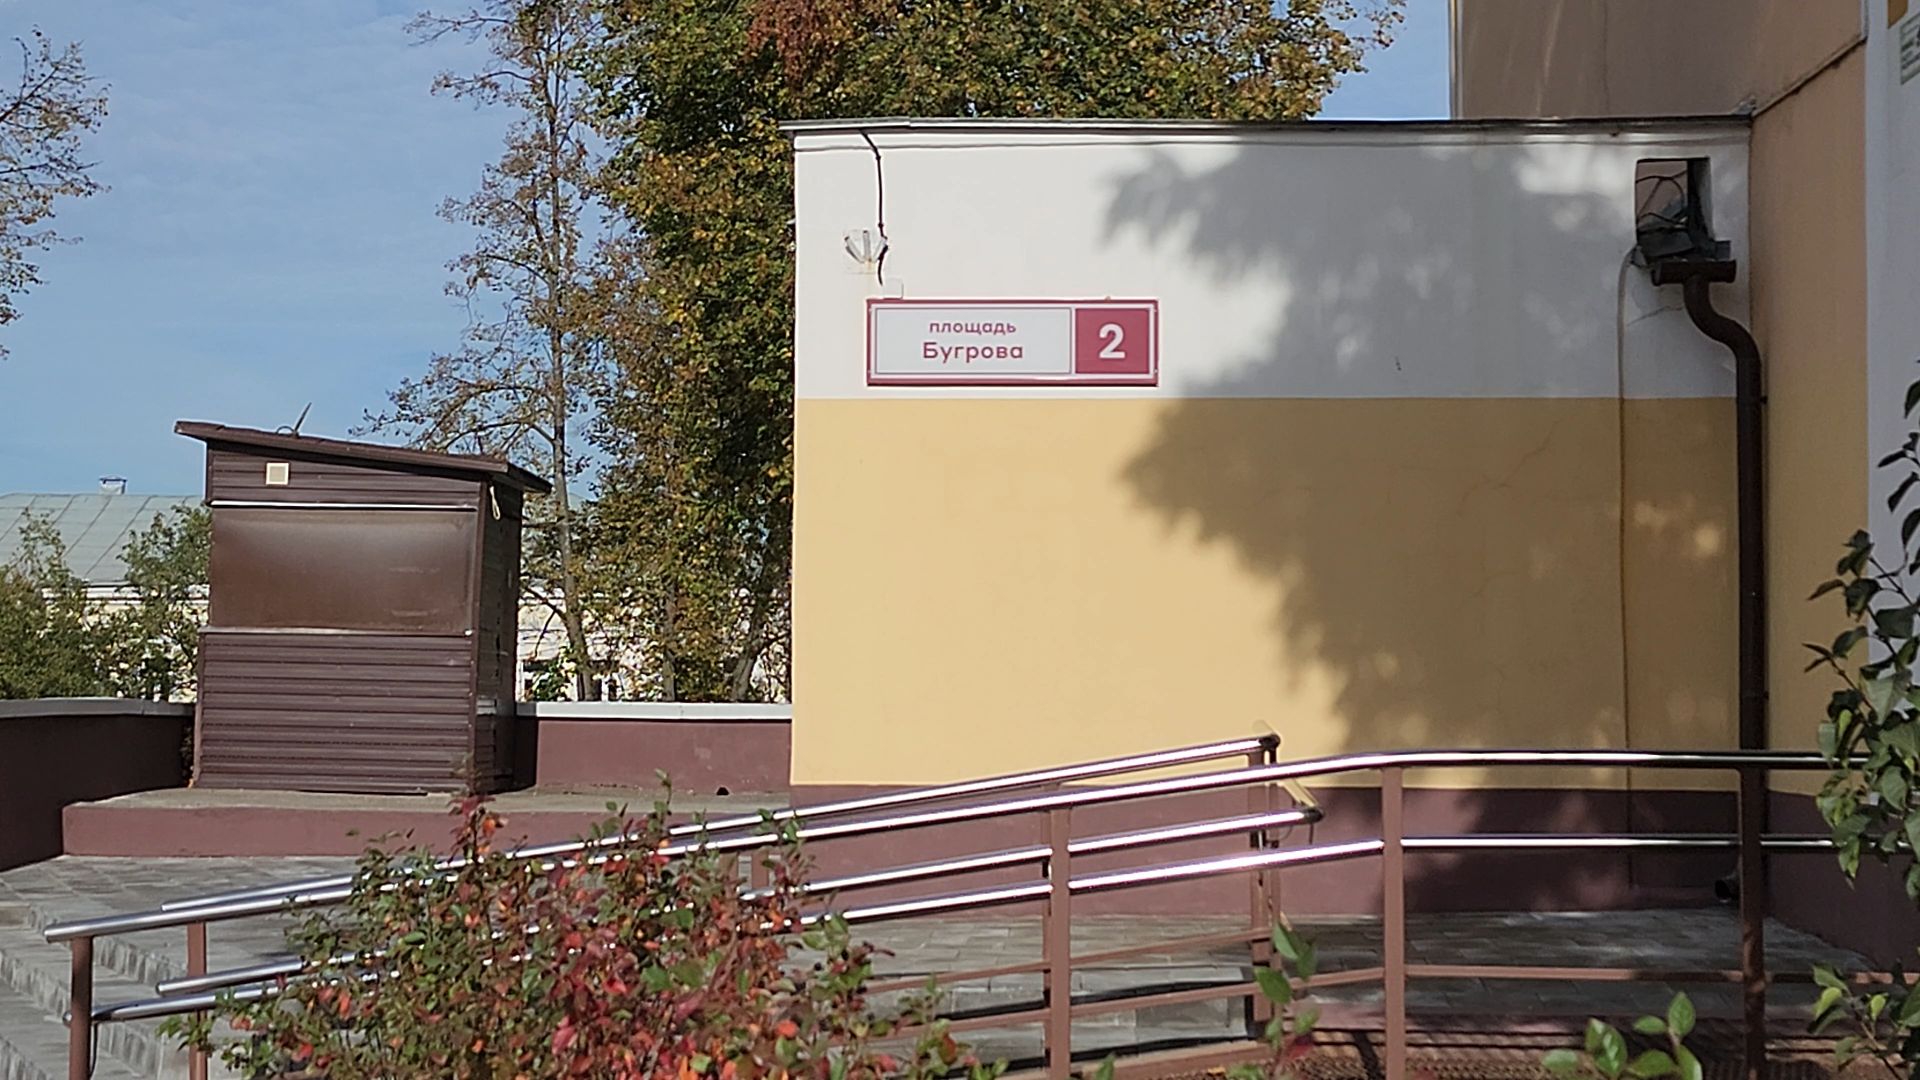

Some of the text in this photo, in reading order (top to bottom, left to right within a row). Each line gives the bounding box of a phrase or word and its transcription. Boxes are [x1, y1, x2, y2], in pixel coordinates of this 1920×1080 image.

[929, 320, 1016, 335] площадь
[923, 341, 1023, 363] Бугрова
[1098, 323, 1126, 359] 2
